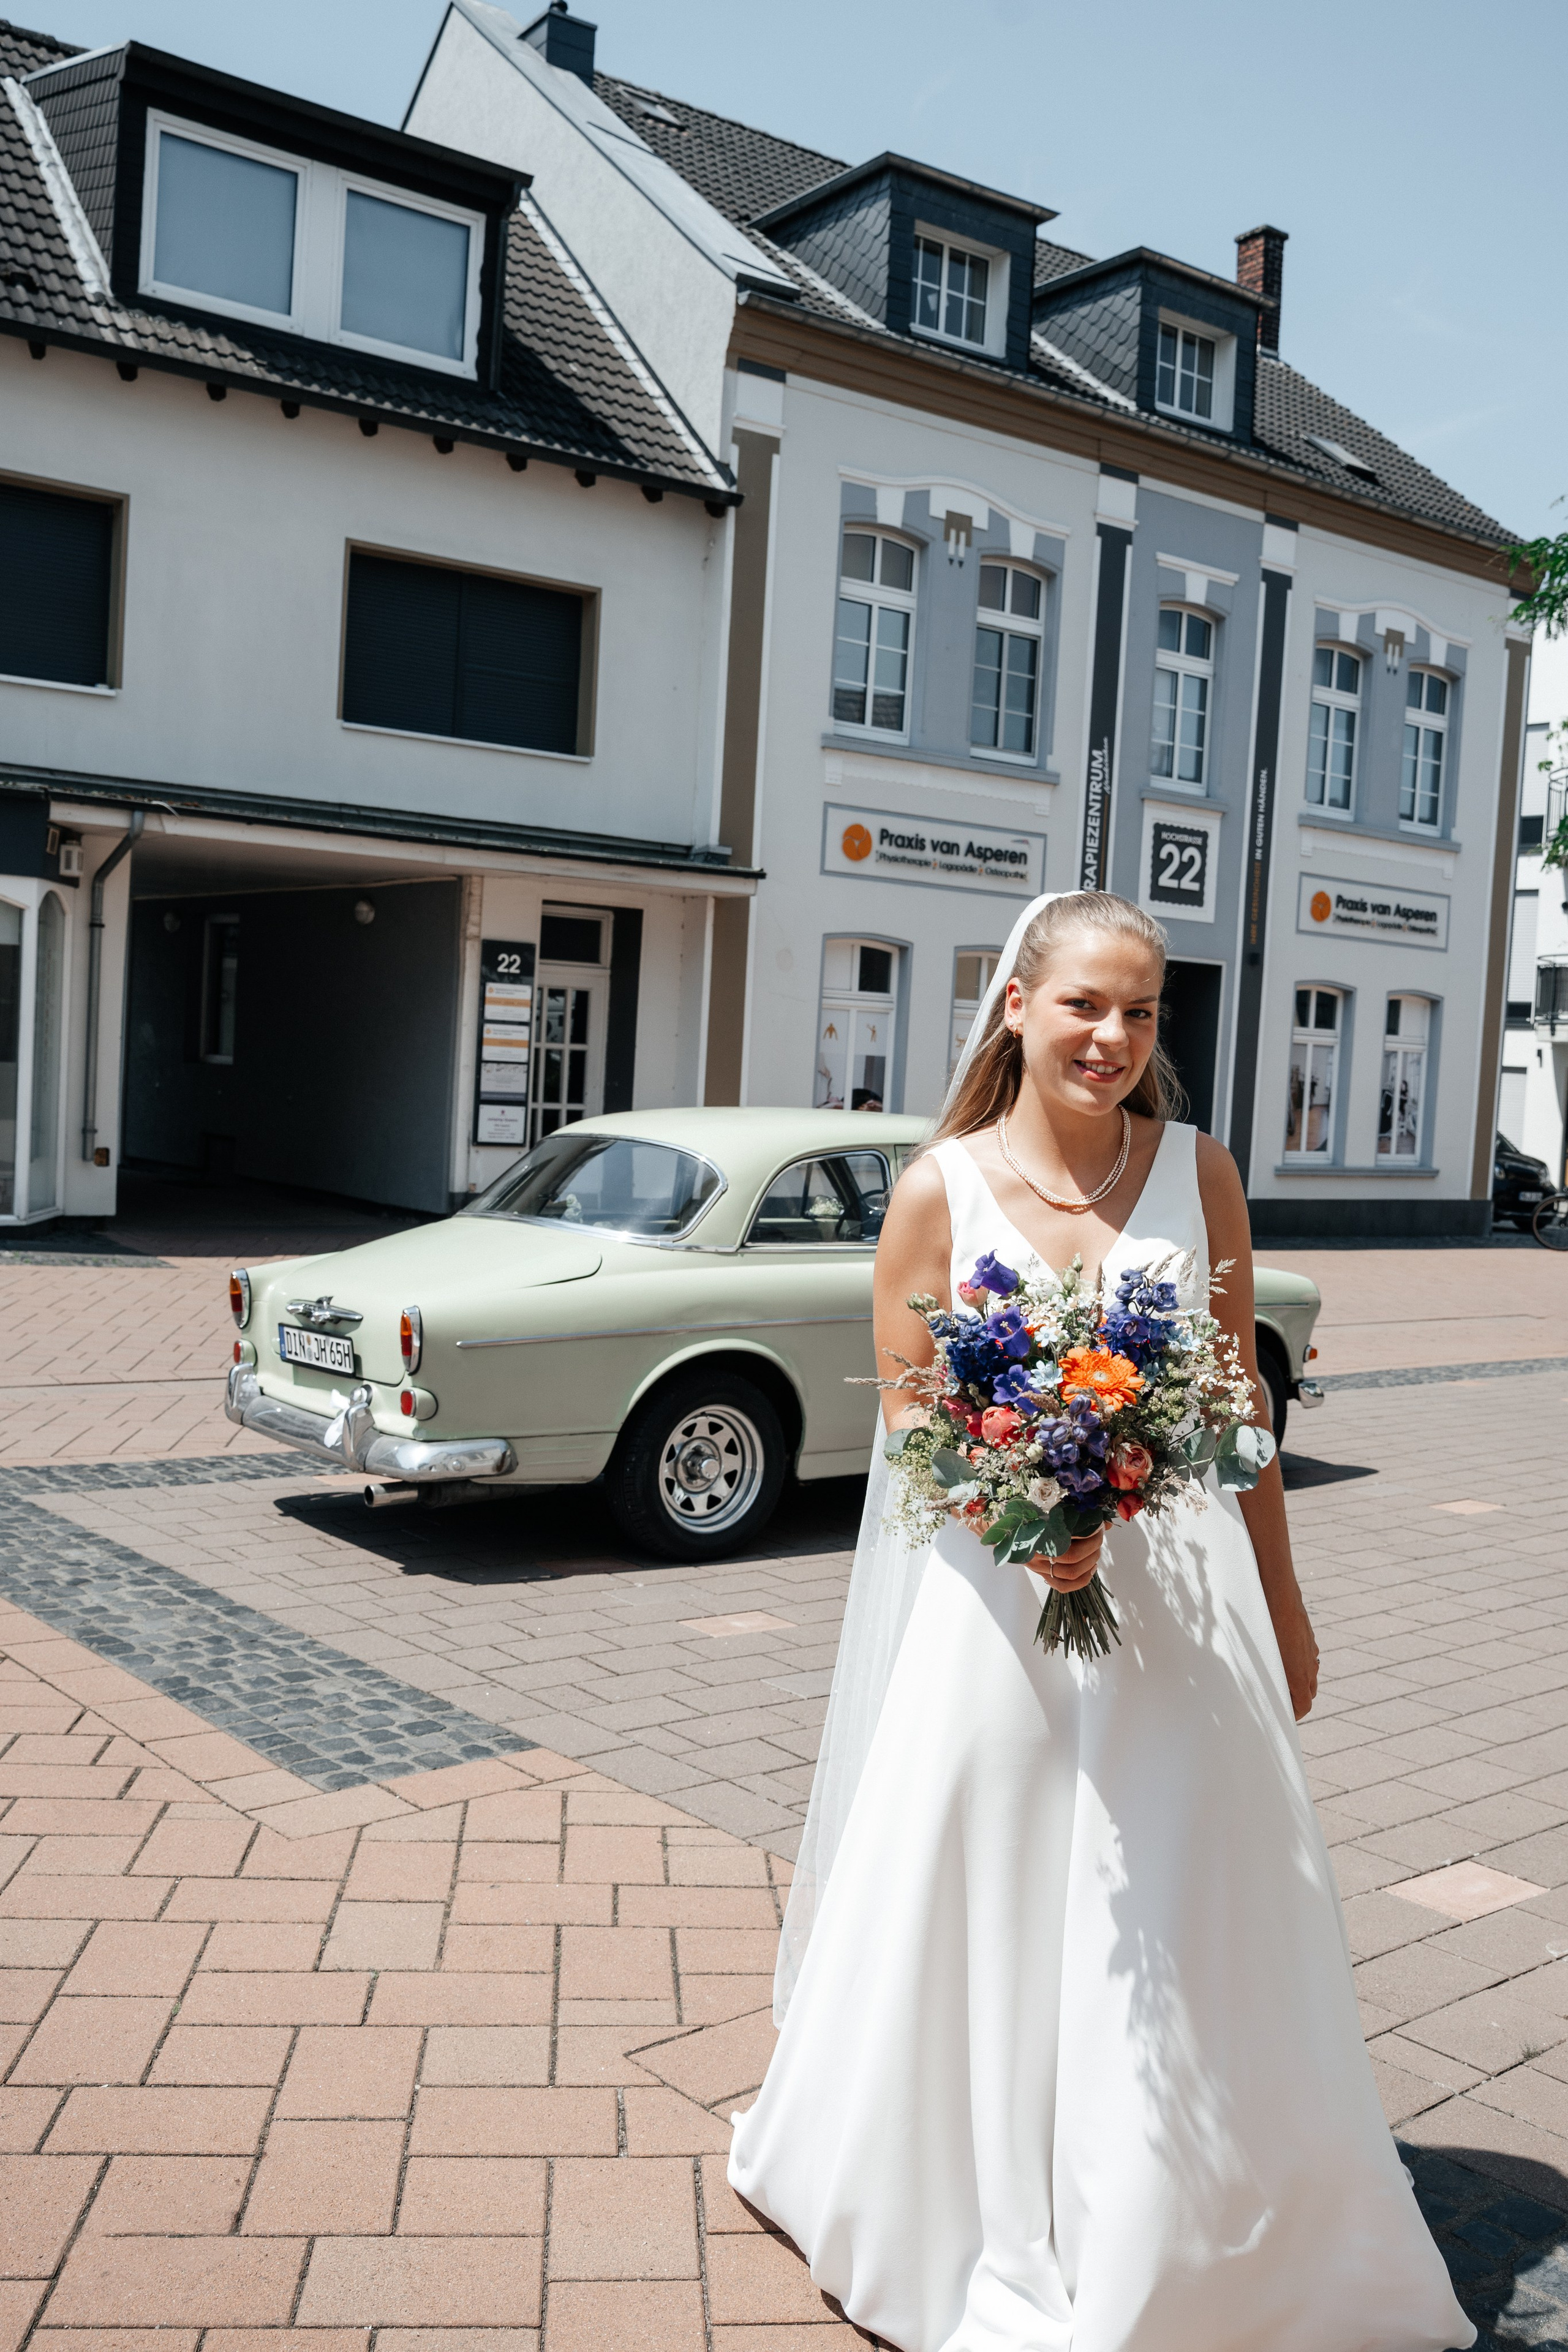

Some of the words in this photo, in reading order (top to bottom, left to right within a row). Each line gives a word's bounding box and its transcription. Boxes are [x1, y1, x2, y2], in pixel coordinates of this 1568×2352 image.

[1161, 831, 1203, 846] HOCHSTRASSE
[1256, 814, 1265, 846] GUTEN
[879, 827, 925, 851] Praxis
[930, 839, 960, 855] van
[965, 841, 1027, 865] Asperen
[879, 853, 931, 867] Physiotherapie
[1254, 850, 1263, 861] IN
[1158, 843, 1202, 891] 22
[1336, 894, 1367, 913] Praxis
[1371, 903, 1390, 916] van
[1394, 903, 1437, 922] Asperen
[497, 953, 521, 974] 22
[286, 1331, 306, 1358] DIN
[314, 1338, 327, 1363] JH
[330, 1341, 351, 1368] 65H
